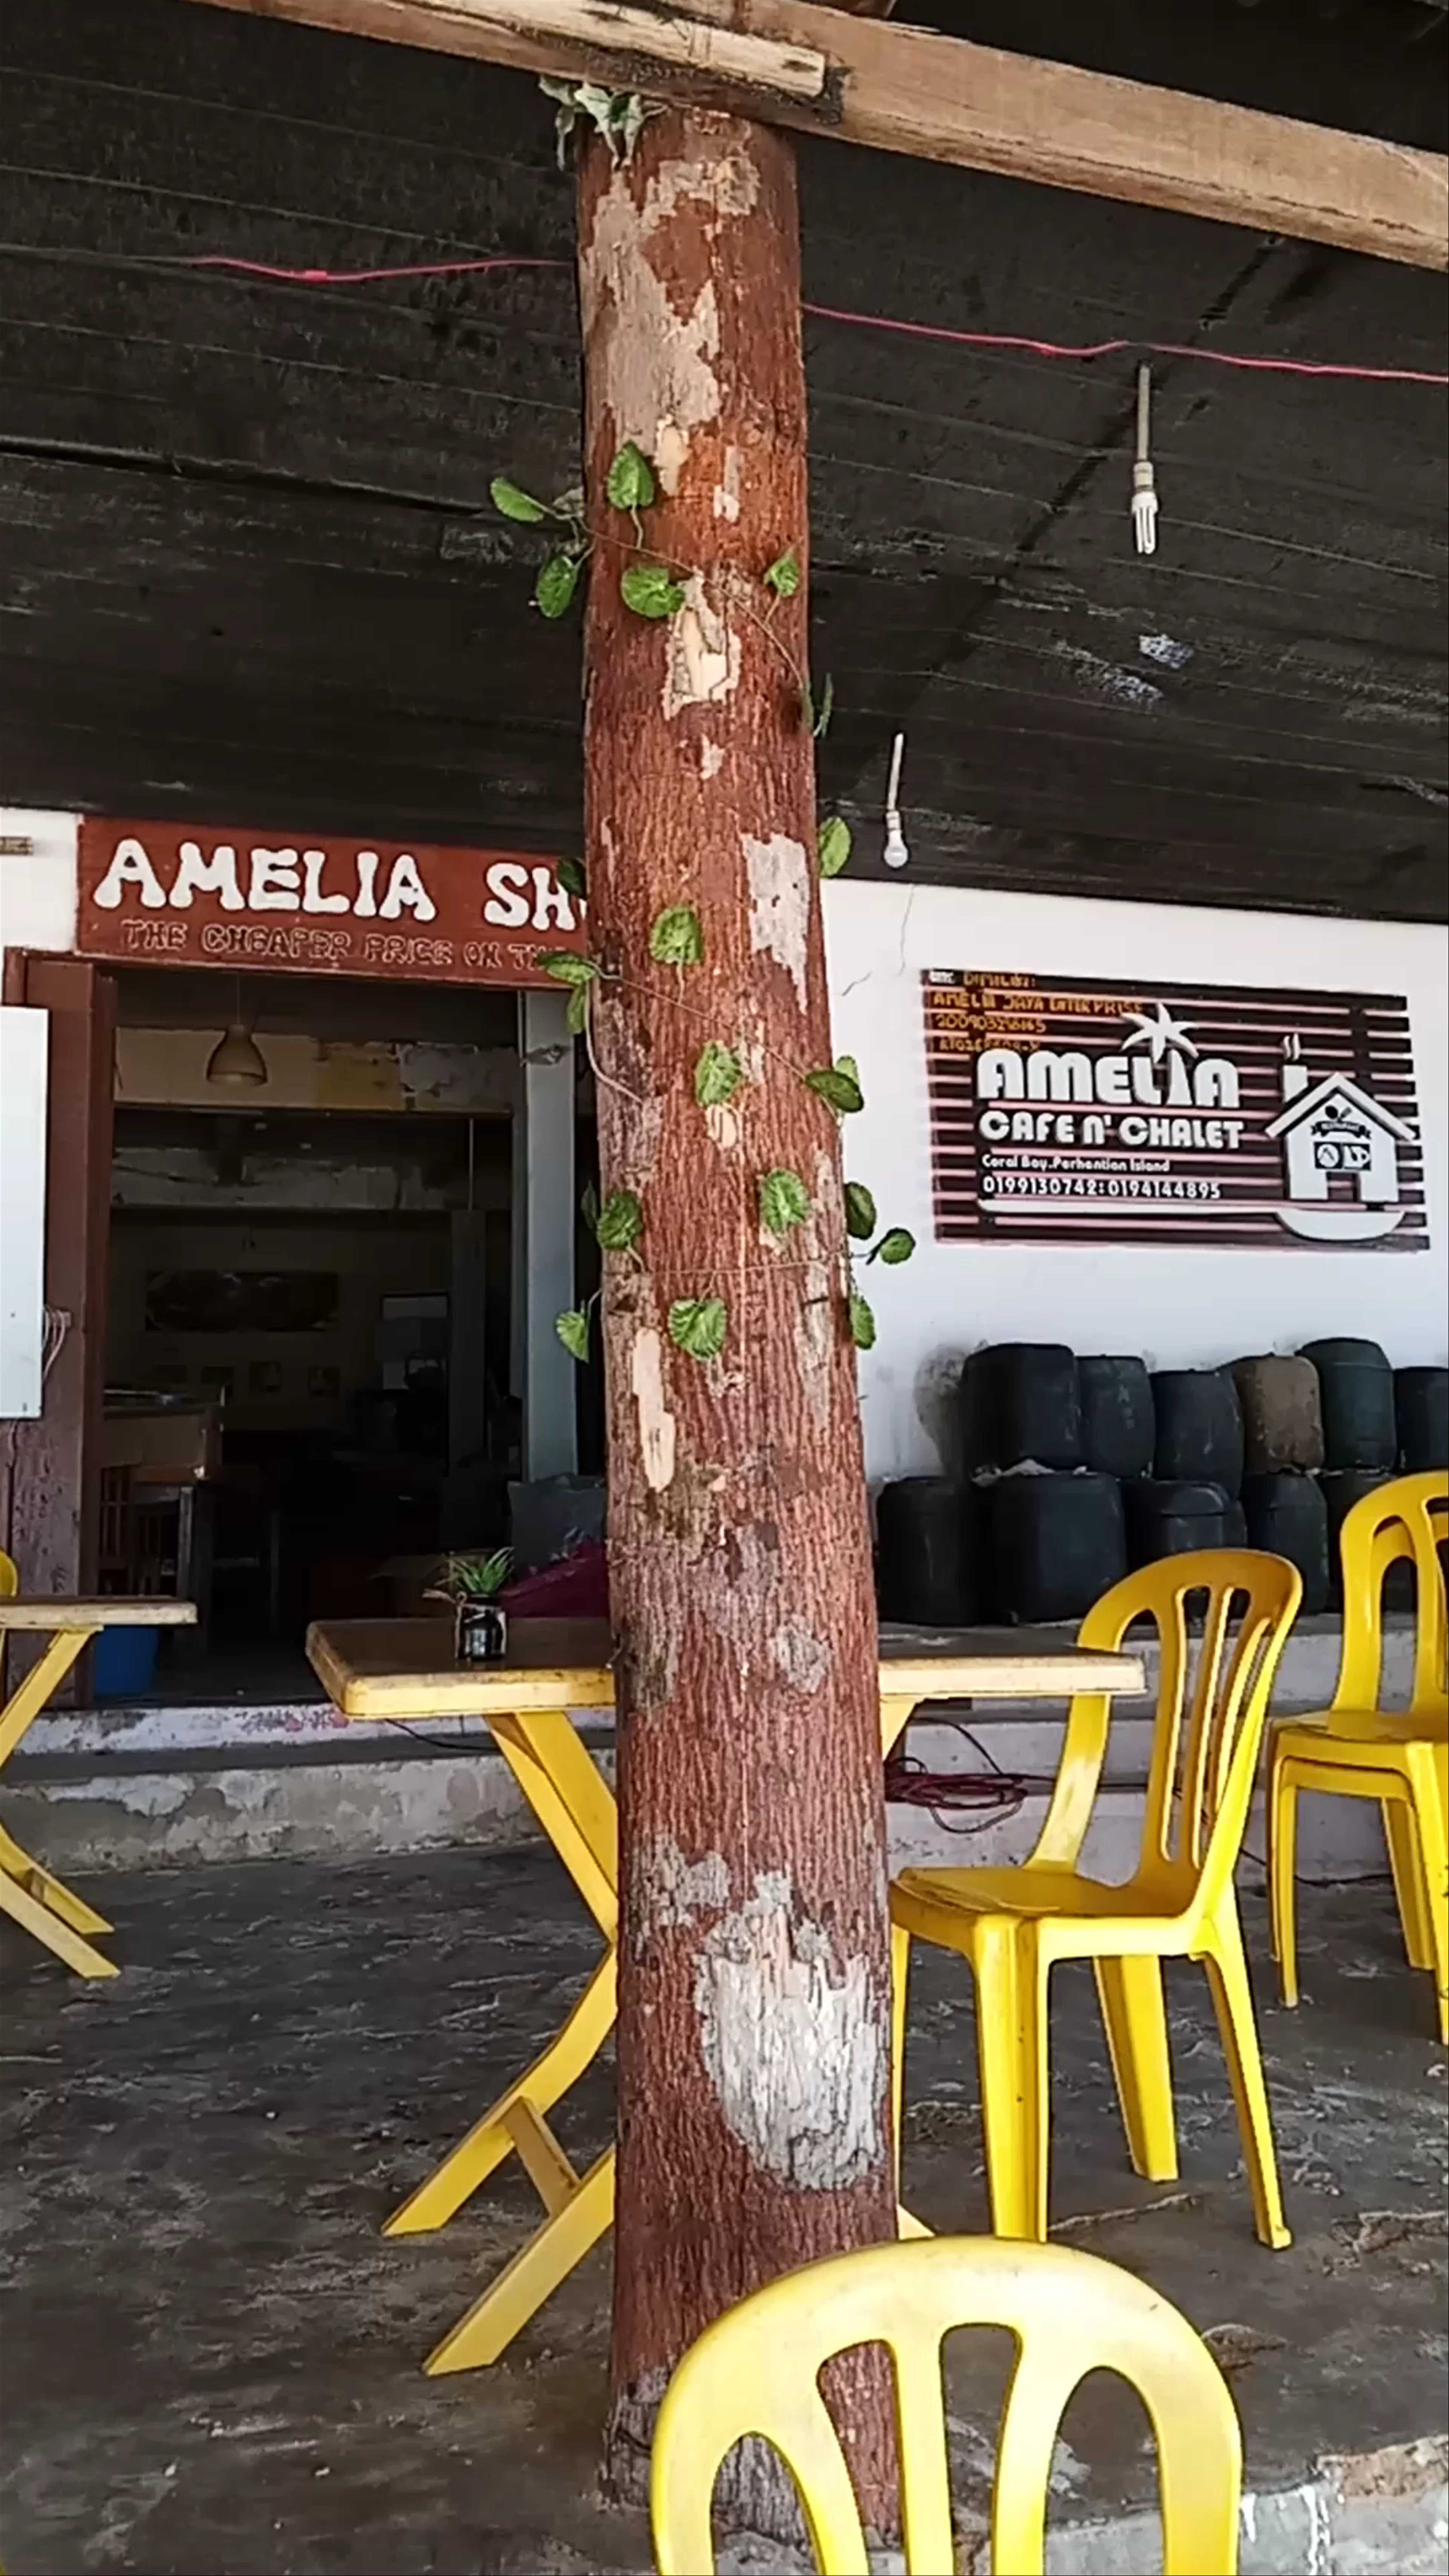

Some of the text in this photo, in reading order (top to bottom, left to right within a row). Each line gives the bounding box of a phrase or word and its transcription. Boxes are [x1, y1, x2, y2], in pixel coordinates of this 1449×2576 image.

[93, 838, 586, 930] AMELIA SH
[120, 920, 188, 950] THE
[977, 1048, 1240, 1107] AMELIA
[980, 1110, 1074, 1143] CAFE
[1119, 1117, 1244, 1149] CHALET
[982, 1154, 1018, 1167] Coral
[1130, 1158, 1170, 1172] Island
